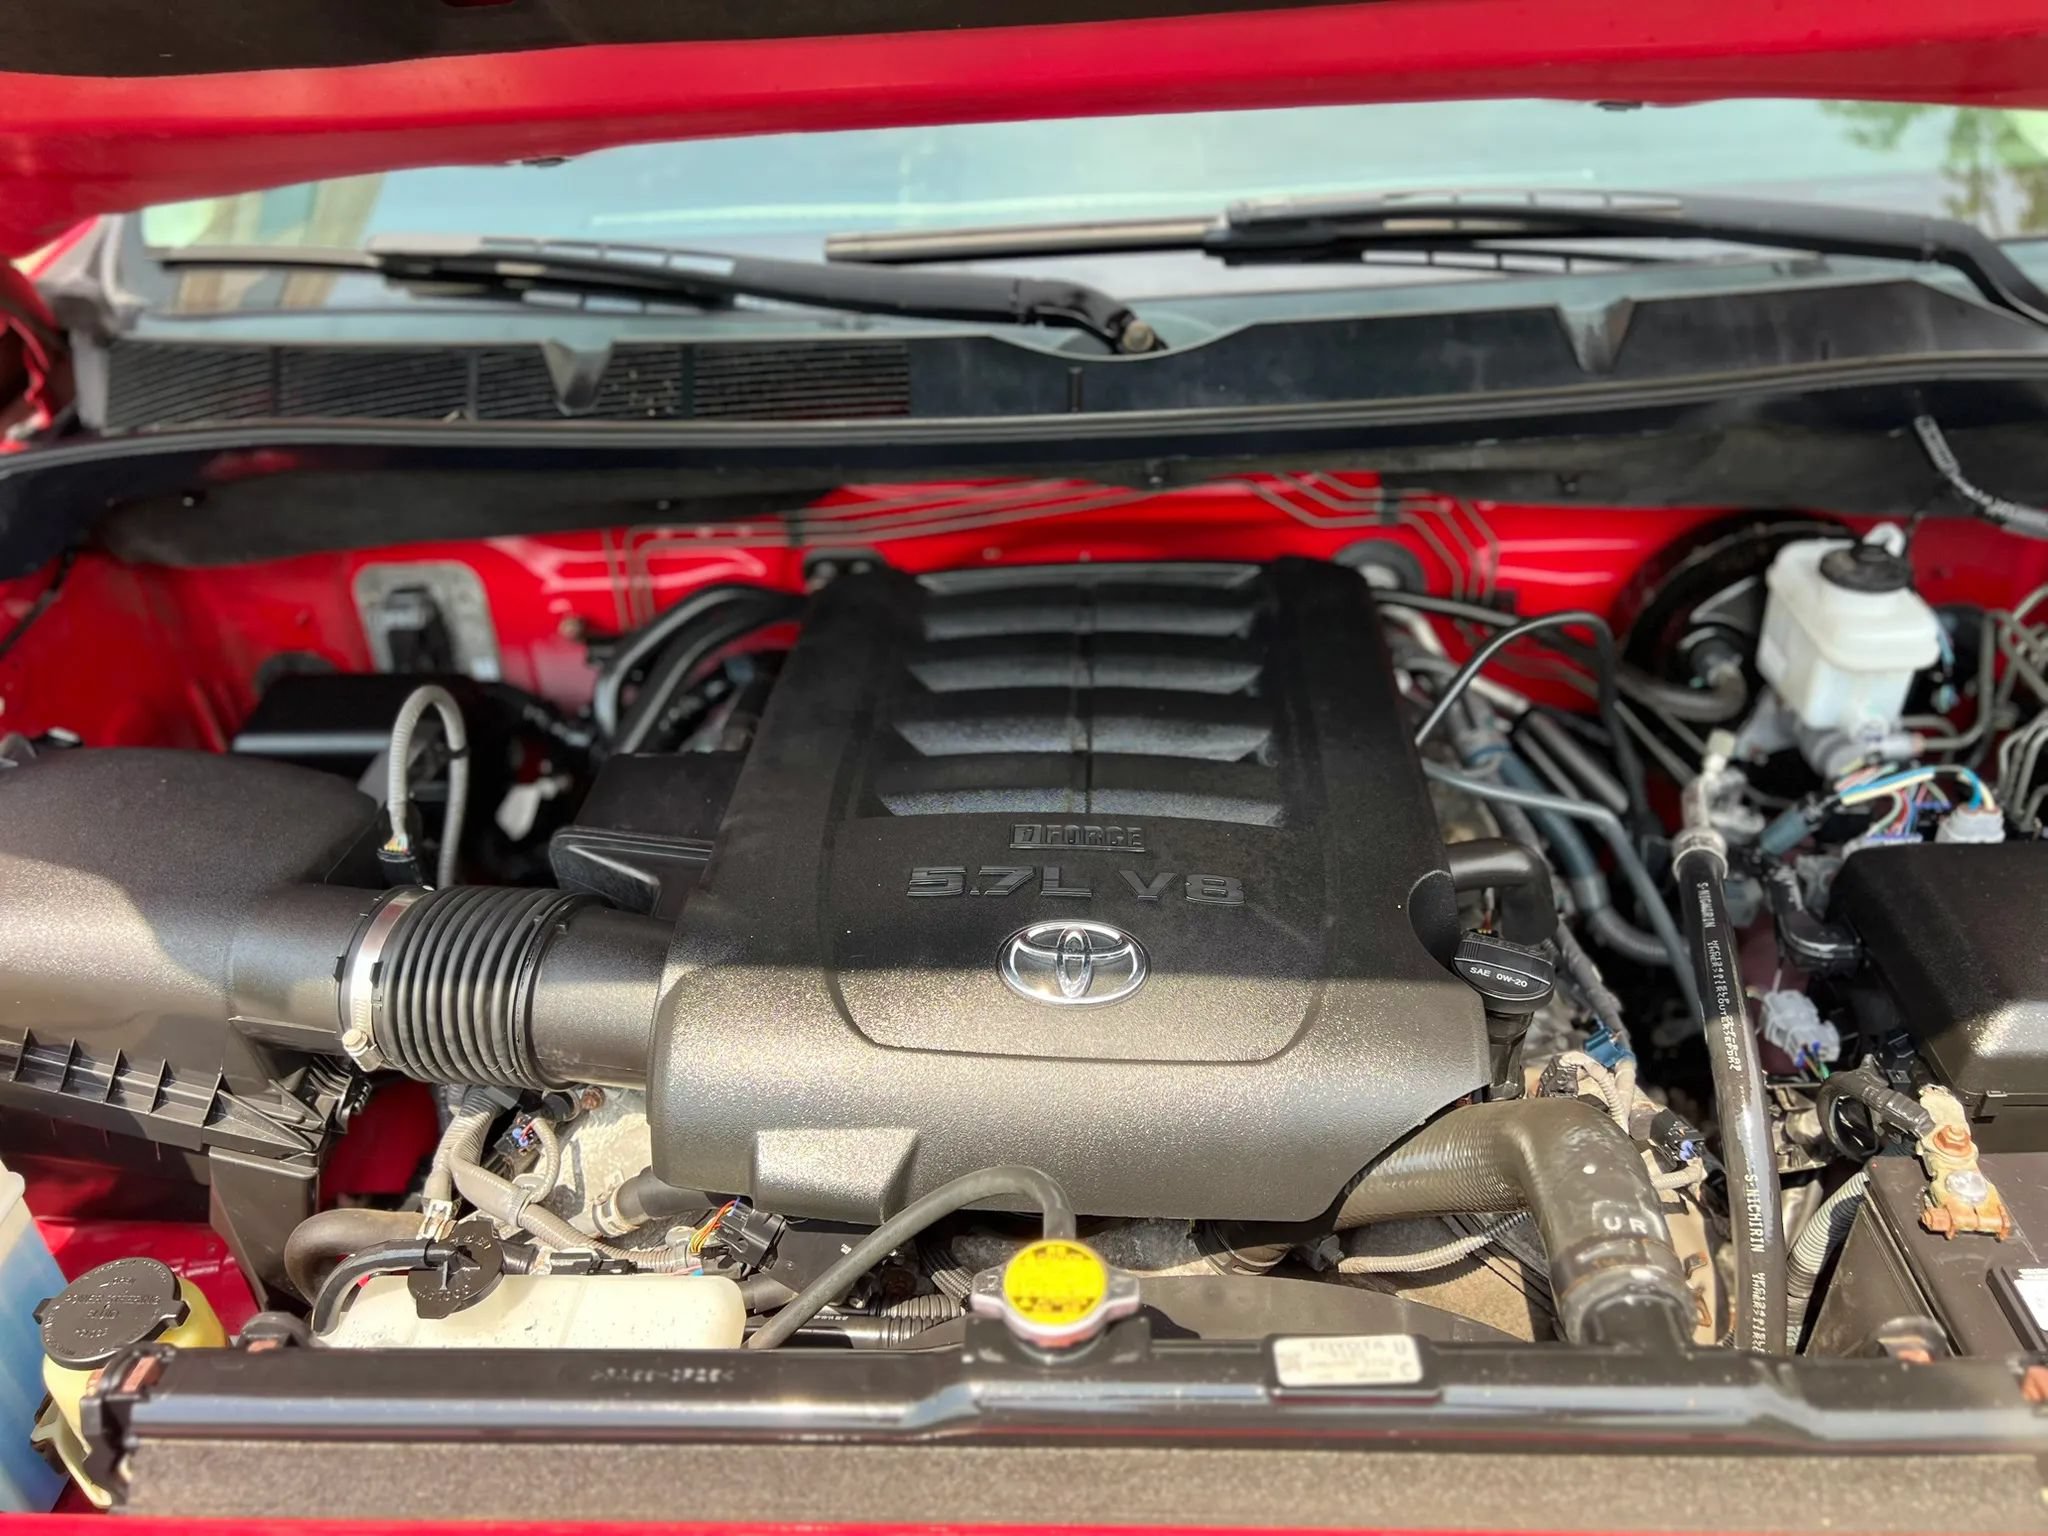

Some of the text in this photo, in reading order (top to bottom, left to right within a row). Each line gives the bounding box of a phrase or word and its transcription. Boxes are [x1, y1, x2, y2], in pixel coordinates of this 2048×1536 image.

[906, 865, 1246, 906] 5.7L V8
[1469, 966, 1528, 988] SAE 0W-20
